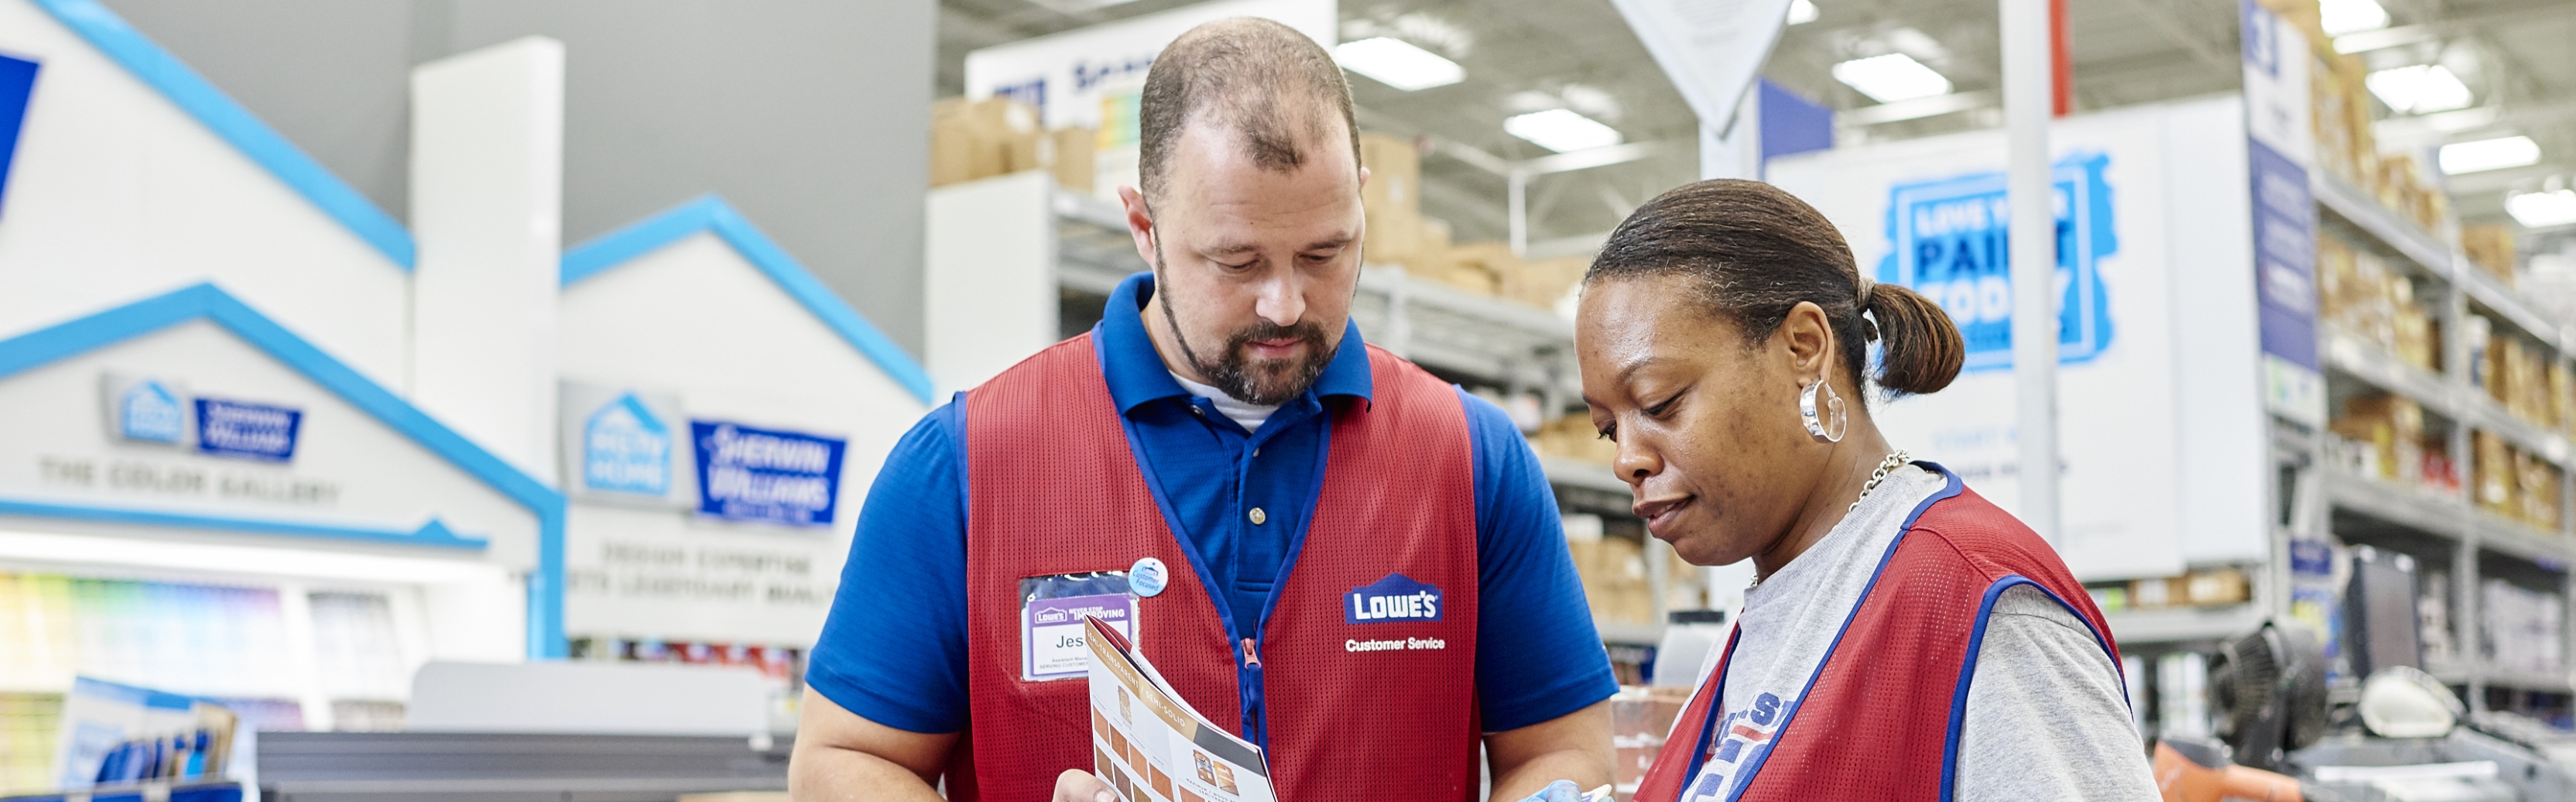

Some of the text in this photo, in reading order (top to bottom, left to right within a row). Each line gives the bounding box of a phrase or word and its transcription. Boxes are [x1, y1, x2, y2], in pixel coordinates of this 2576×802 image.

[1917, 220, 2071, 278] PAIT
[706, 423, 831, 475] SHERWIN
[39, 458, 92, 485] THE
[108, 463, 204, 492] COLOR
[708, 464, 830, 511] WILLIAMS
[1132, 570, 1159, 584] Customer
[1136, 578, 1159, 591] Focused
[1038, 612, 1064, 622] LOWE'S
[1354, 591, 1436, 619] LOWE'S
[1056, 636, 1087, 648] Jes
[1345, 637, 1445, 652] Customer Service
[1087, 629, 1139, 687] SEMI-TRANSPARENT
[1146, 691, 1185, 727] SEMI-SOLID
